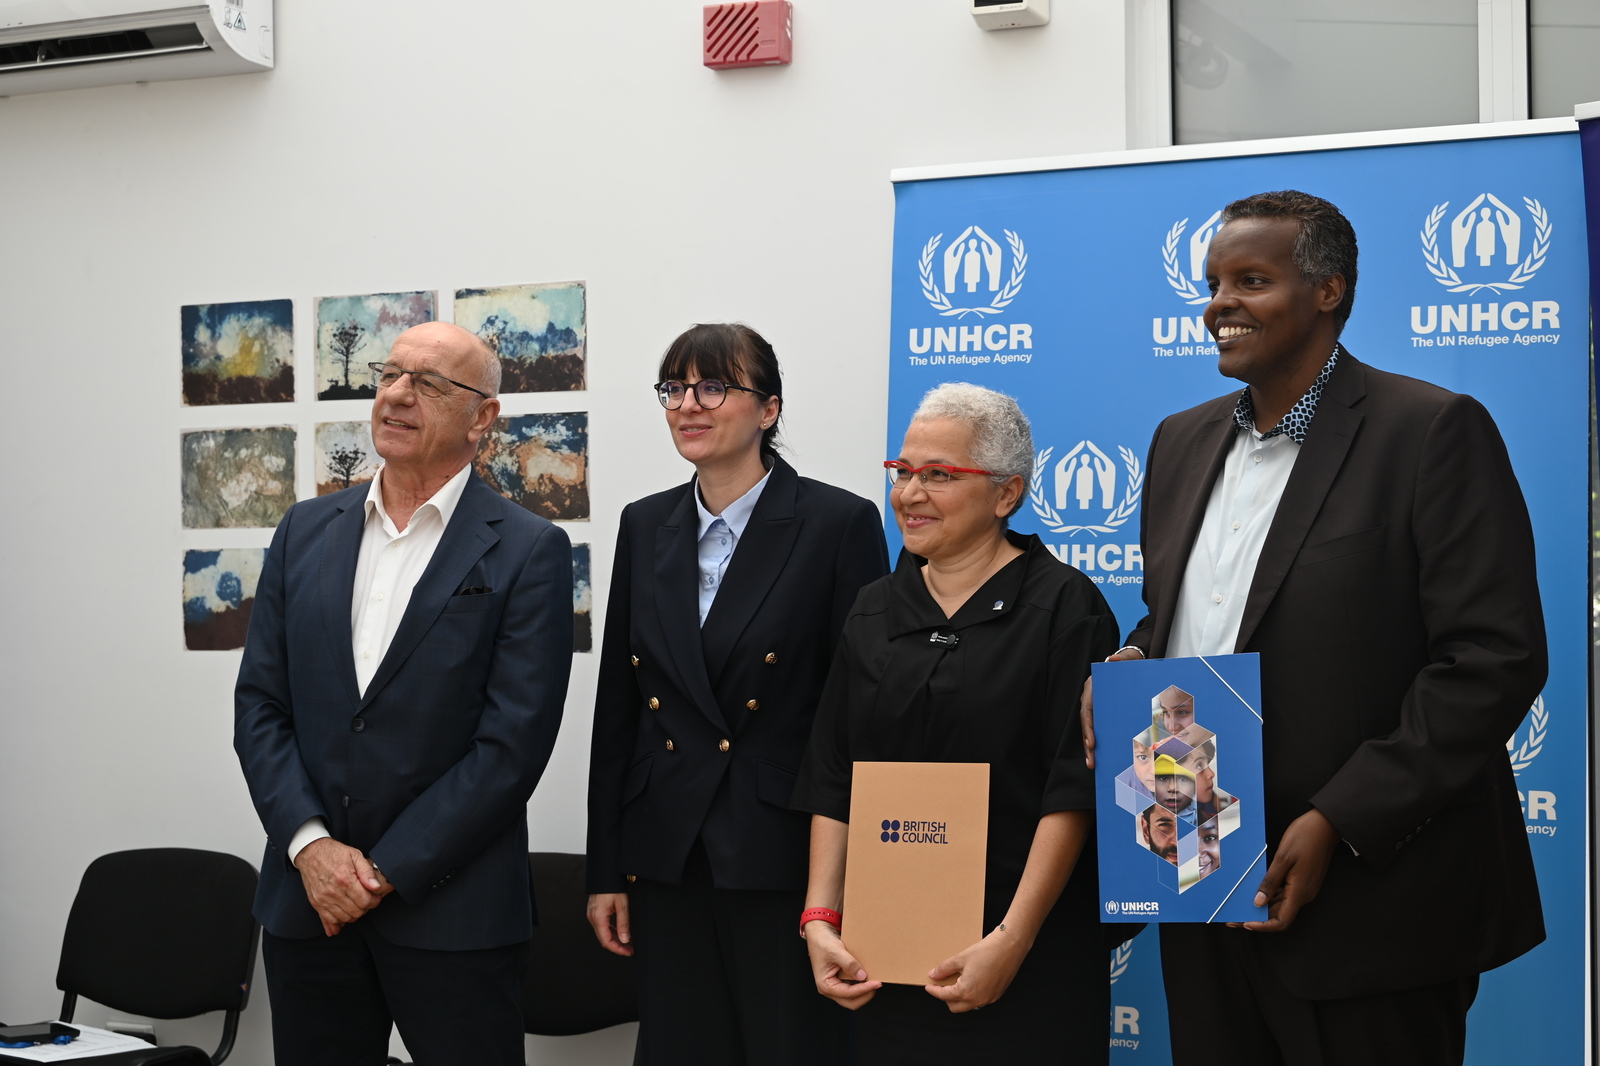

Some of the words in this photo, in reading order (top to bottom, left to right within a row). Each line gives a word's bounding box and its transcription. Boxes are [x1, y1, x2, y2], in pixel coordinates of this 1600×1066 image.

[1411, 300, 1560, 334] UNHCR
[1153, 316, 1217, 344] UN
[909, 323, 1033, 354] UNHCR
[1411, 337, 1433, 347] The
[1436, 336, 1455, 346] UN
[1458, 335, 1509, 347] Refugee
[1512, 333, 1560, 345] Agency
[1153, 347, 1174, 357] The
[1176, 346, 1193, 356] UN
[909, 356, 928, 366] The
[930, 355, 946, 365] UN
[948, 354, 991, 366] Refugee
[993, 353, 1032, 364] Agency
[1107, 574, 1144, 586] Agenc
[903, 821, 946, 832] BRITISH
[902, 832, 948, 844] COUNCIL
[1121, 902, 1159, 911] UNHCR
